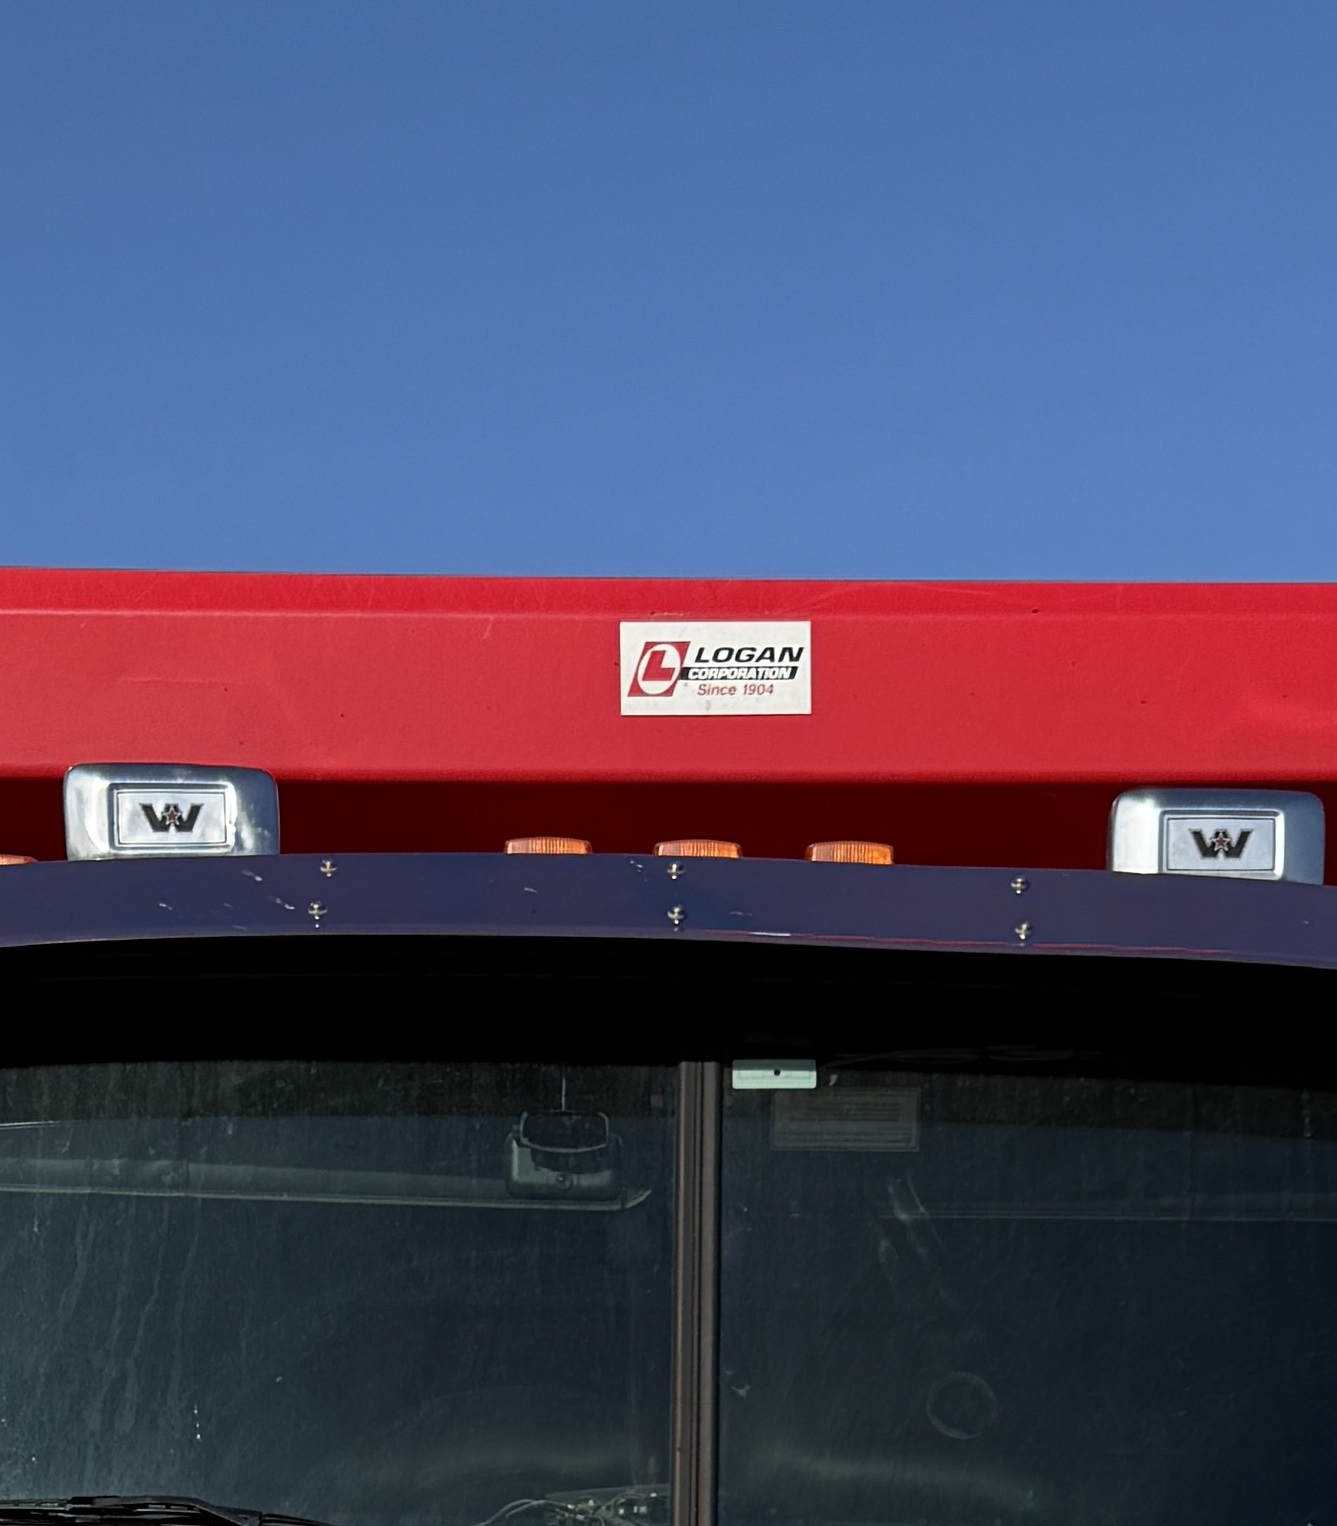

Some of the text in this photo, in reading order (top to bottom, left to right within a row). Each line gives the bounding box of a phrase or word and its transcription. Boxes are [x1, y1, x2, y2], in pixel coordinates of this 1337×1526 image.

[695, 647, 804, 662] LOGAN
[688, 668, 791, 680] CORPORATION
[698, 684, 774, 695] Since 1904
